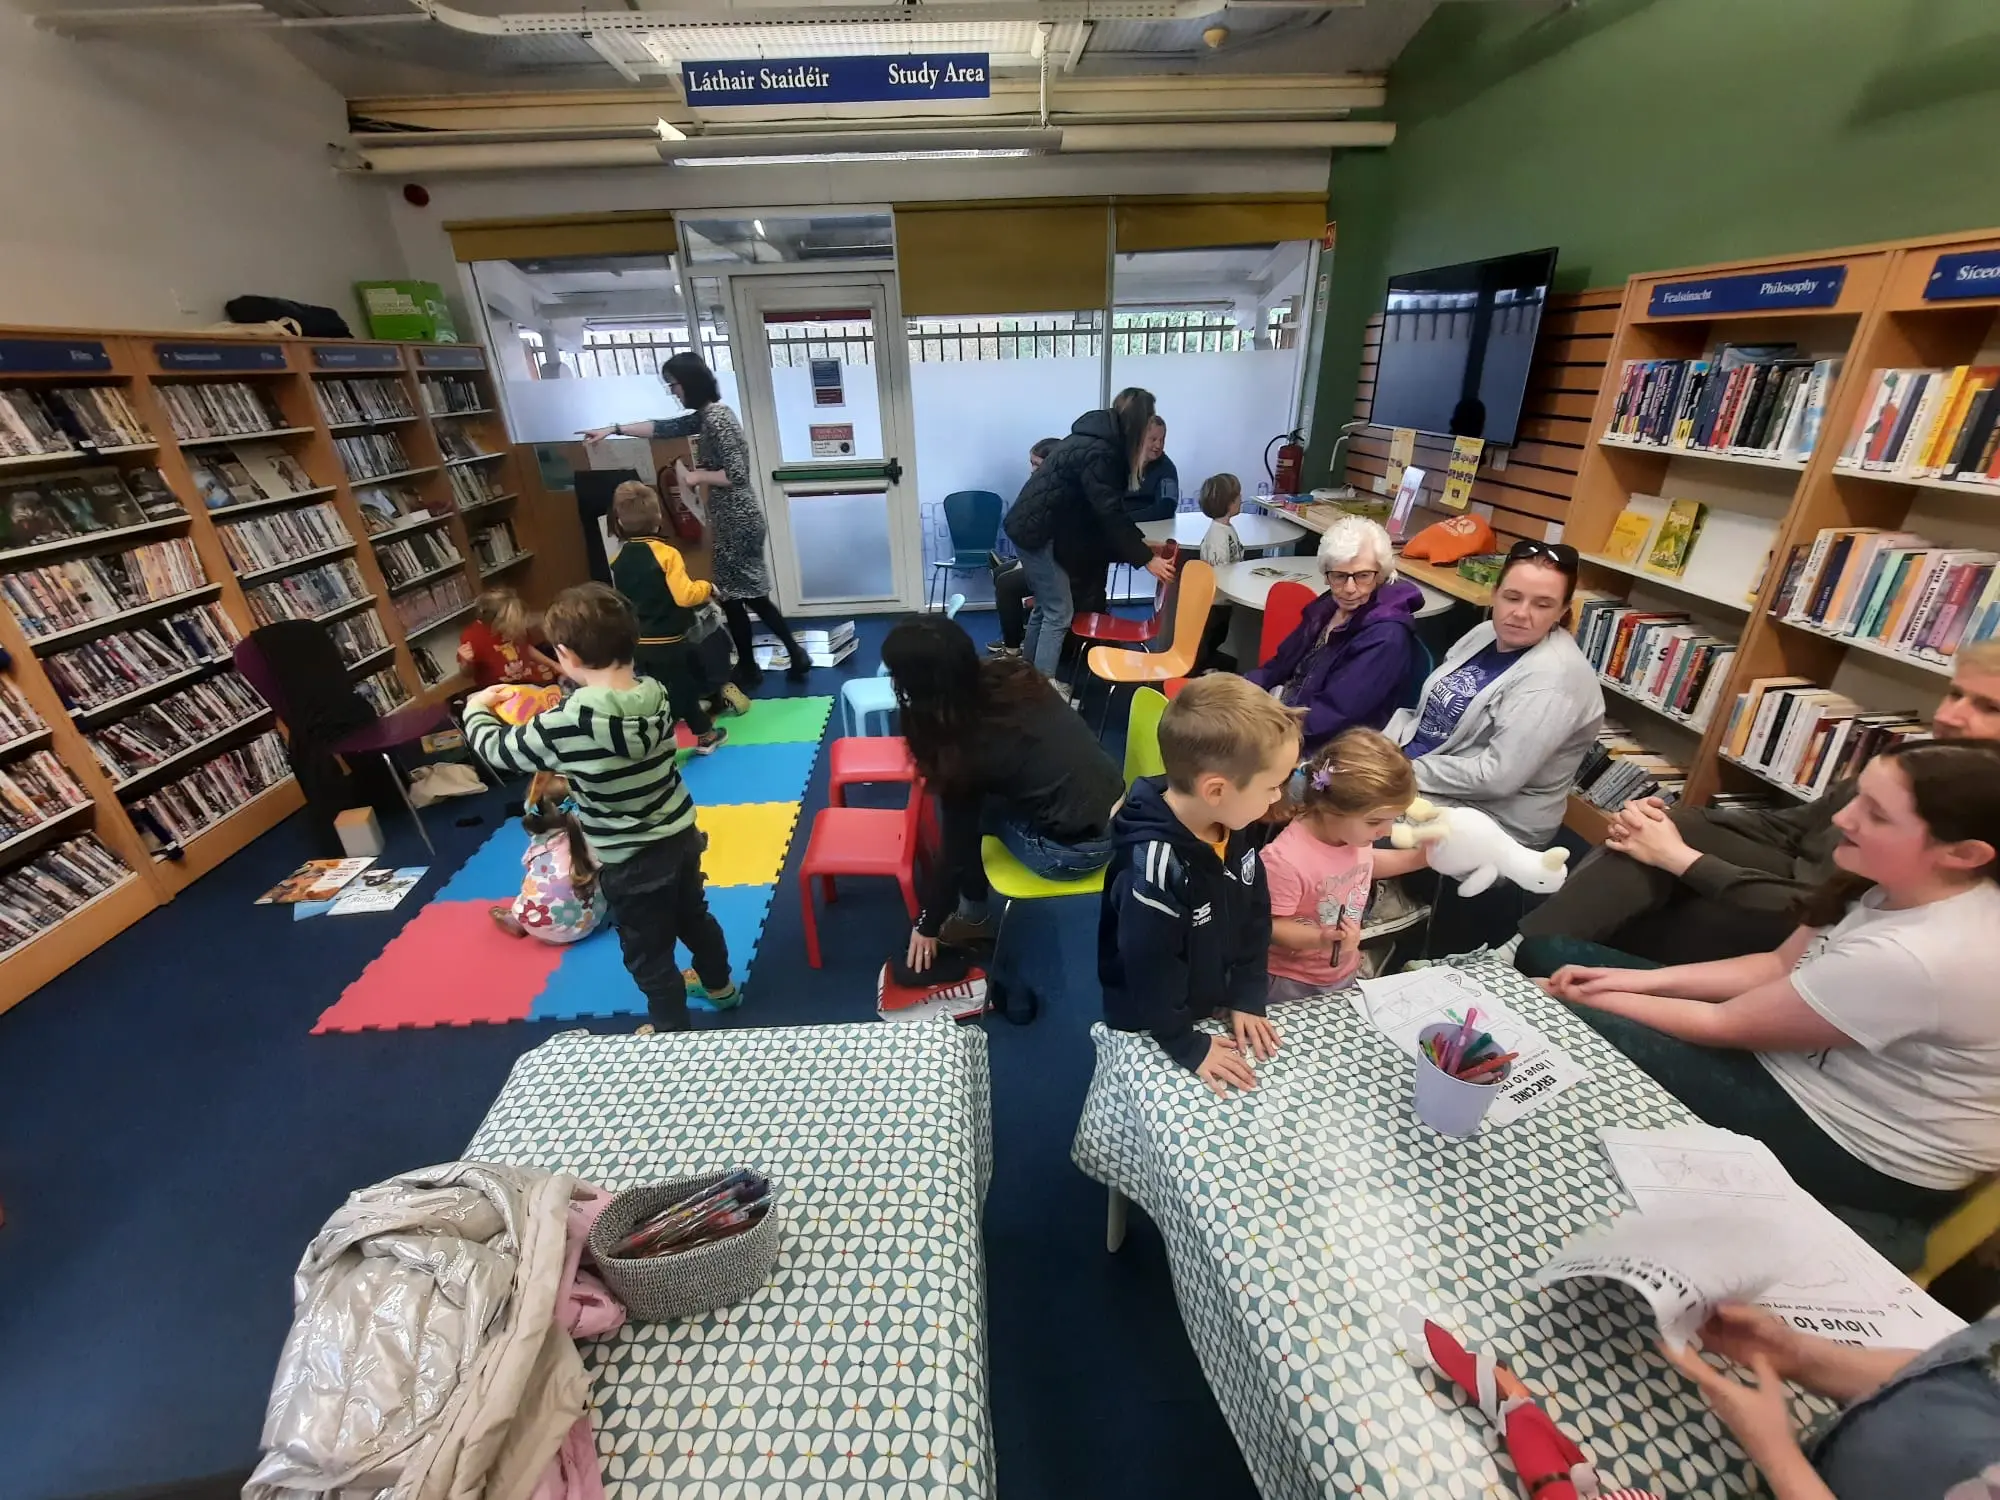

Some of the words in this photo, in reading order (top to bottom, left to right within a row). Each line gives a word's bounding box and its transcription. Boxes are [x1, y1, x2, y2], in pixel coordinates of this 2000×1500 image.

[688, 69, 755, 91] Láthair
[760, 66, 829, 89] Staidéir
[888, 61, 940, 89] Study
[944, 61, 985, 82] Area
[1759, 279, 1820, 295] Philosophy
[1524, 1062, 1551, 1077] love
[1544, 1059, 1556, 1068] I
[1512, 1074, 1529, 1084] to
[1793, 1315, 1819, 1333] to
[1820, 1318, 1871, 1338] love
[1867, 1321, 1883, 1338] I
